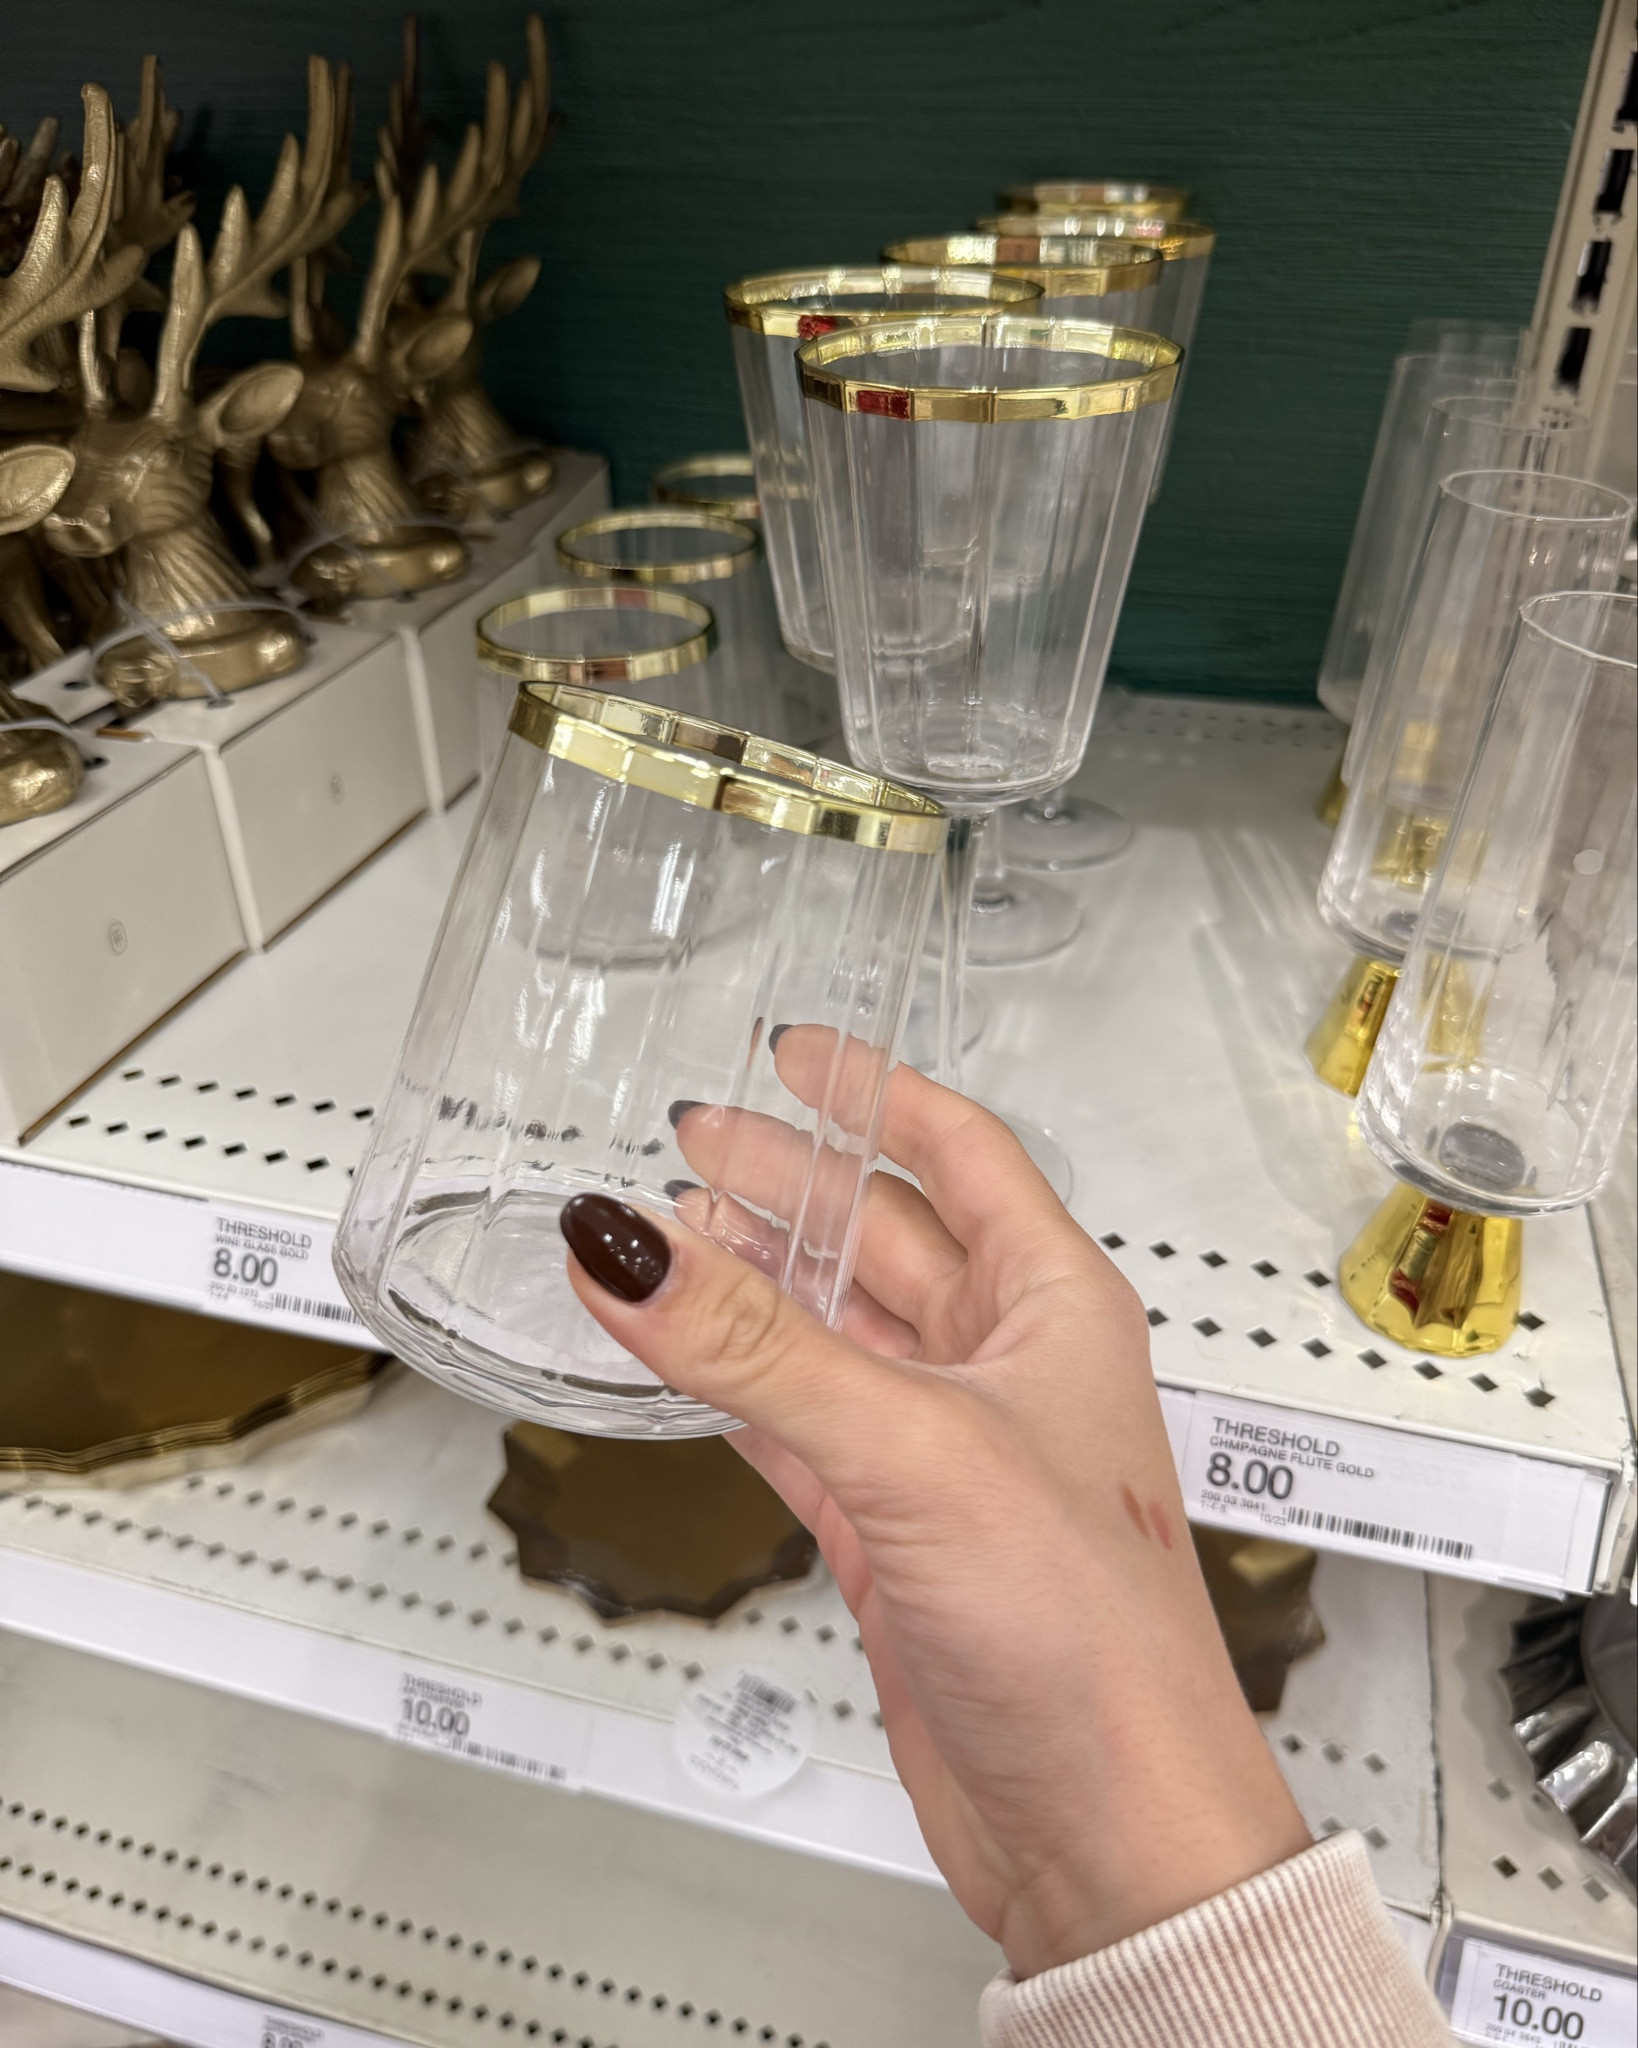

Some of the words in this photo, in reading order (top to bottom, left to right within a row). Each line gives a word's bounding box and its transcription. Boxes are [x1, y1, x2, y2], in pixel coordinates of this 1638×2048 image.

[215, 1234, 240, 1247] WINE
[243, 1240, 277, 1255] GLASS
[279, 1247, 309, 1260] GOLD
[216, 1216, 312, 1249] THRESHOLD
[213, 1248, 278, 1287] 8.00
[1212, 1416, 1340, 1457] THRESHOLD
[1206, 1451, 1294, 1500] 8.00
[1209, 1435, 1287, 1461] CHMPAGNE
[1290, 1451, 1333, 1470] FLUTE
[1336, 1461, 1374, 1478] GOLD
[402, 1697, 470, 1735] 10.00
[1493, 1978, 1547, 2000] COASTER
[1496, 1962, 1603, 2002] THRESHOLD
[1494, 1993, 1584, 2040] 10.00
